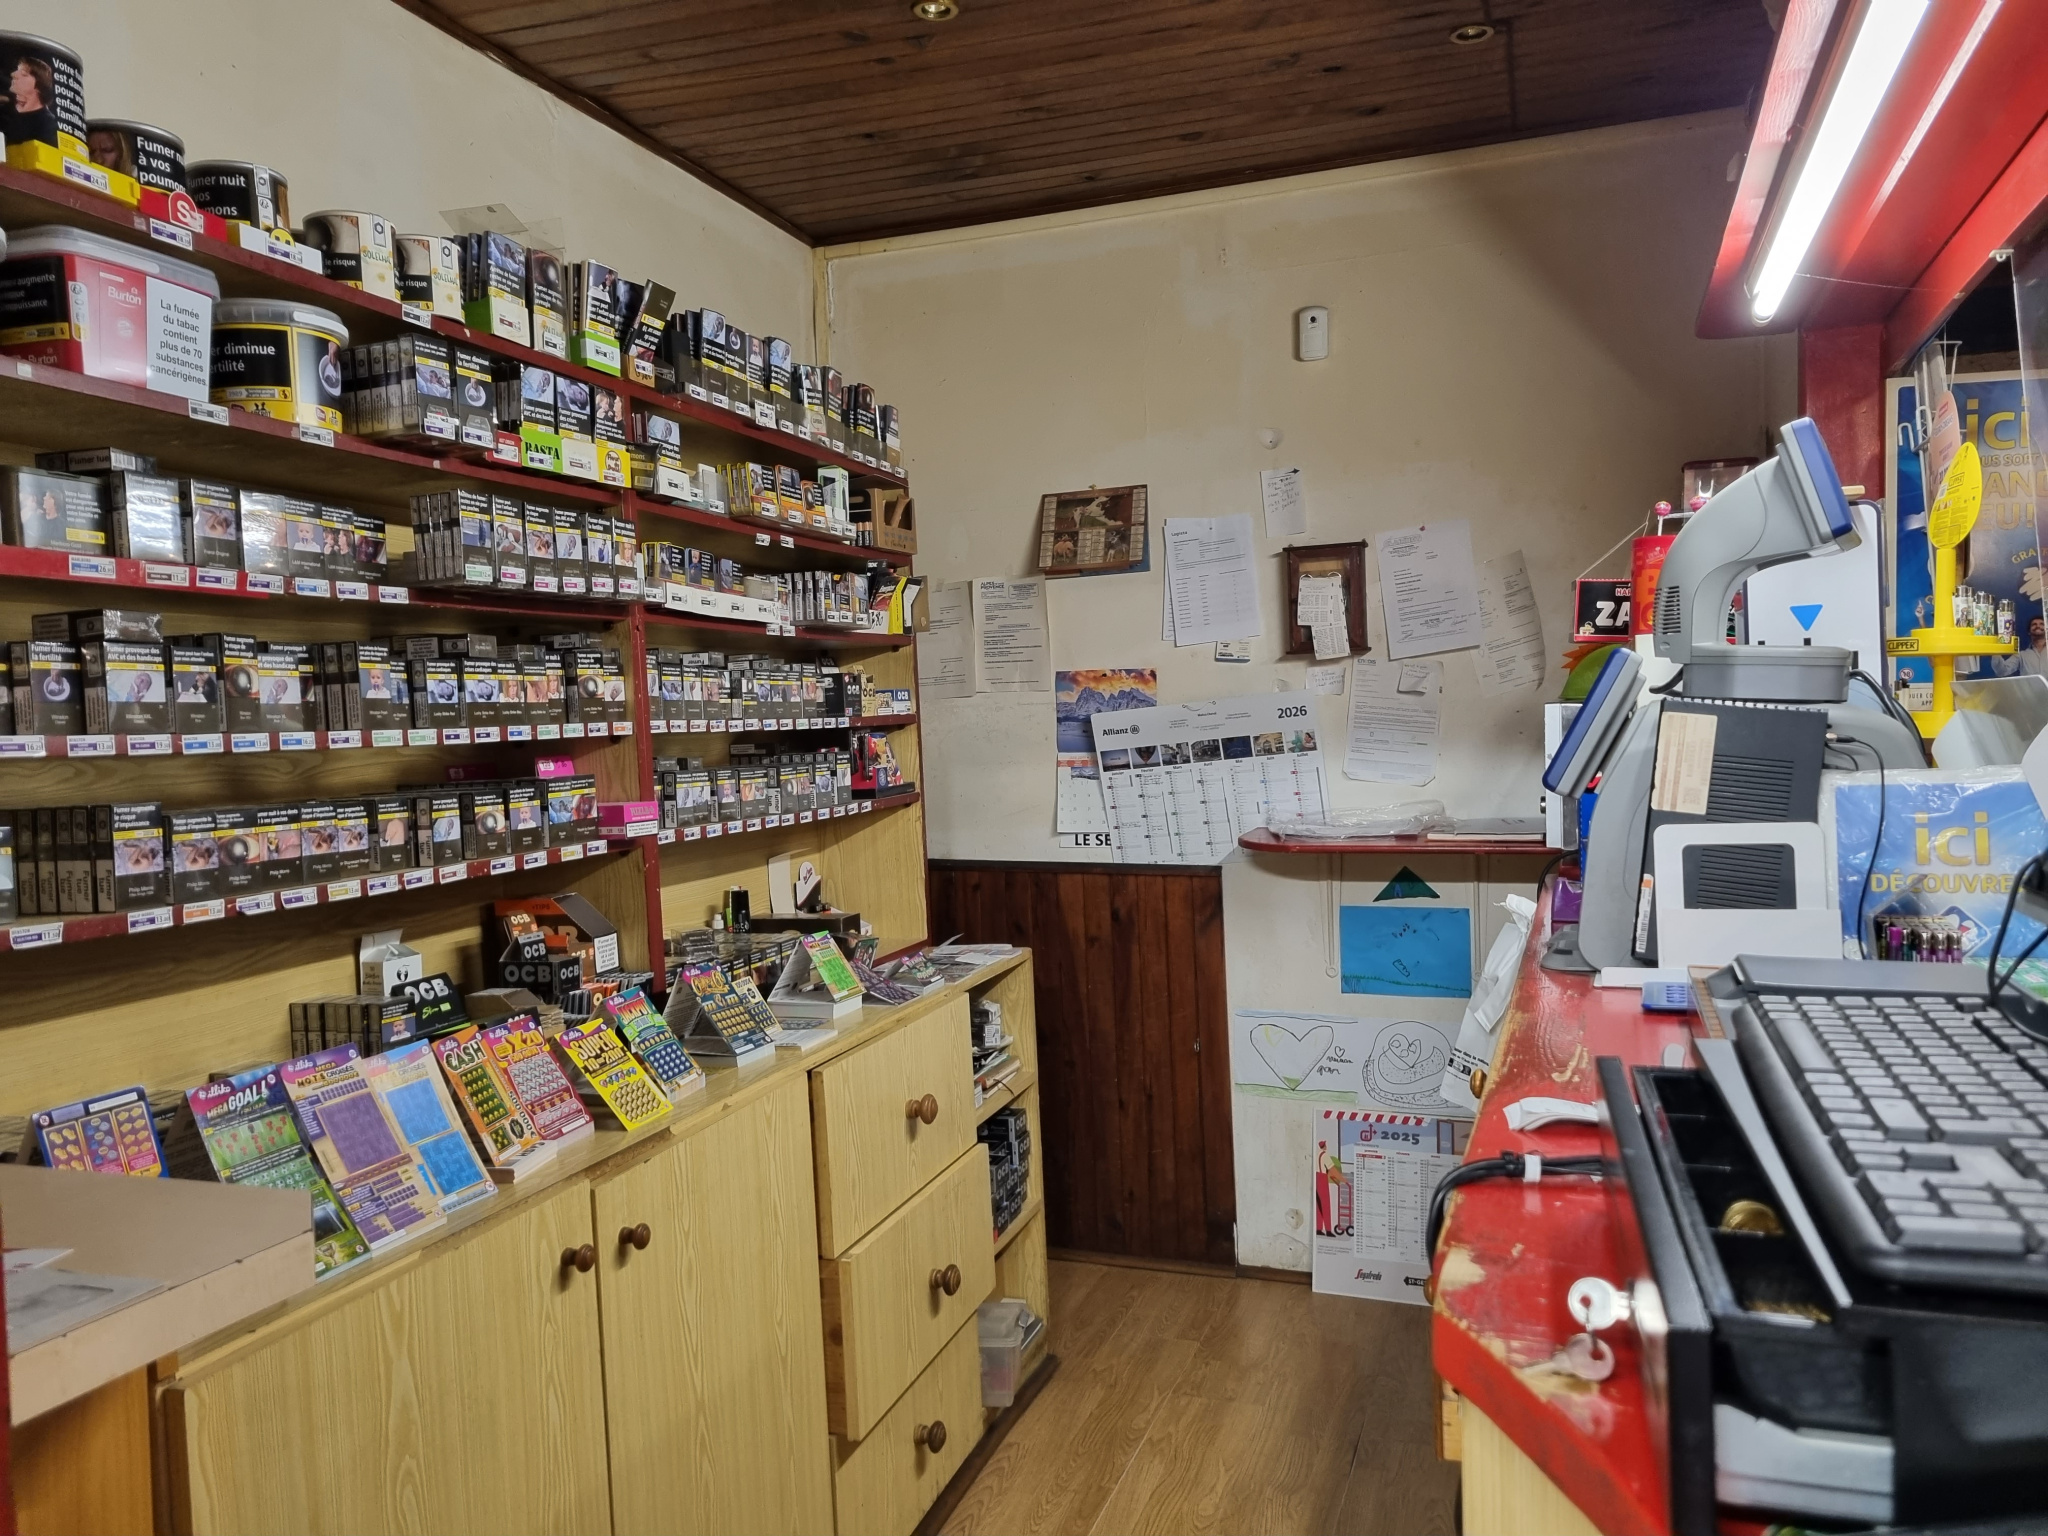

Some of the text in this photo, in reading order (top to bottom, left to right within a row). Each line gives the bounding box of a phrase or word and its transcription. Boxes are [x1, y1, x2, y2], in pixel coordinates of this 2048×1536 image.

[53, 71, 67, 85] est
[137, 135, 175, 159] Fumer
[138, 152, 171, 172] à vos
[219, 173, 246, 188] nuit
[332, 257, 357, 269] risque
[405, 278, 428, 289] risque
[107, 286, 142, 306] Burton
[160, 299, 200, 320] La fumée
[163, 313, 200, 333] du tabac
[163, 328, 198, 345] contient
[160, 339, 203, 359] plus de 70
[224, 343, 276, 356] diminue
[156, 351, 204, 373] substances
[209, 359, 245, 373] ertilité
[150, 363, 208, 387] cancérigènes.
[1965, 397, 2031, 452] ici
[524, 441, 560, 460] RASTA
[31, 643, 75, 654] Fumer diminue
[107, 646, 159, 656] Fumer provoque des
[1888, 641, 1917, 650] CLIPPER
[32, 653, 62, 662] la fertilité
[107, 653, 120, 661] AVC
[127, 653, 136, 661] des
[136, 654, 162, 663] handicaps
[263, 655, 285, 664] provoque
[273, 662, 296, 670] handicaps
[847, 684, 860, 695] OCB
[897, 691, 909, 700] OCB
[1277, 704, 1308, 720] 2026
[1102, 726, 1129, 737] Allianz
[131, 805, 156, 814] augmente
[114, 821, 150, 829] d'impuissance
[1074, 833, 1091, 847] LE
[1914, 810, 1992, 867] ici
[1870, 868, 2026, 894] DÉCOUVRE
[510, 913, 531, 925] OCB
[524, 942, 547, 959] OCB
[504, 964, 551, 983] OCB
[560, 964, 579, 980] OCB
[505, 1030, 544, 1053] X20
[569, 1031, 617, 1060] SUPER
[444, 1038, 487, 1072] CASH
[315, 1061, 337, 1073] MEGA
[326, 1064, 354, 1078] CROISÉS
[583, 1057, 600, 1072] 10
[207, 1083, 231, 1099] illiko
[206, 1101, 229, 1119] MEGA
[1380, 1130, 1420, 1146] 2025
